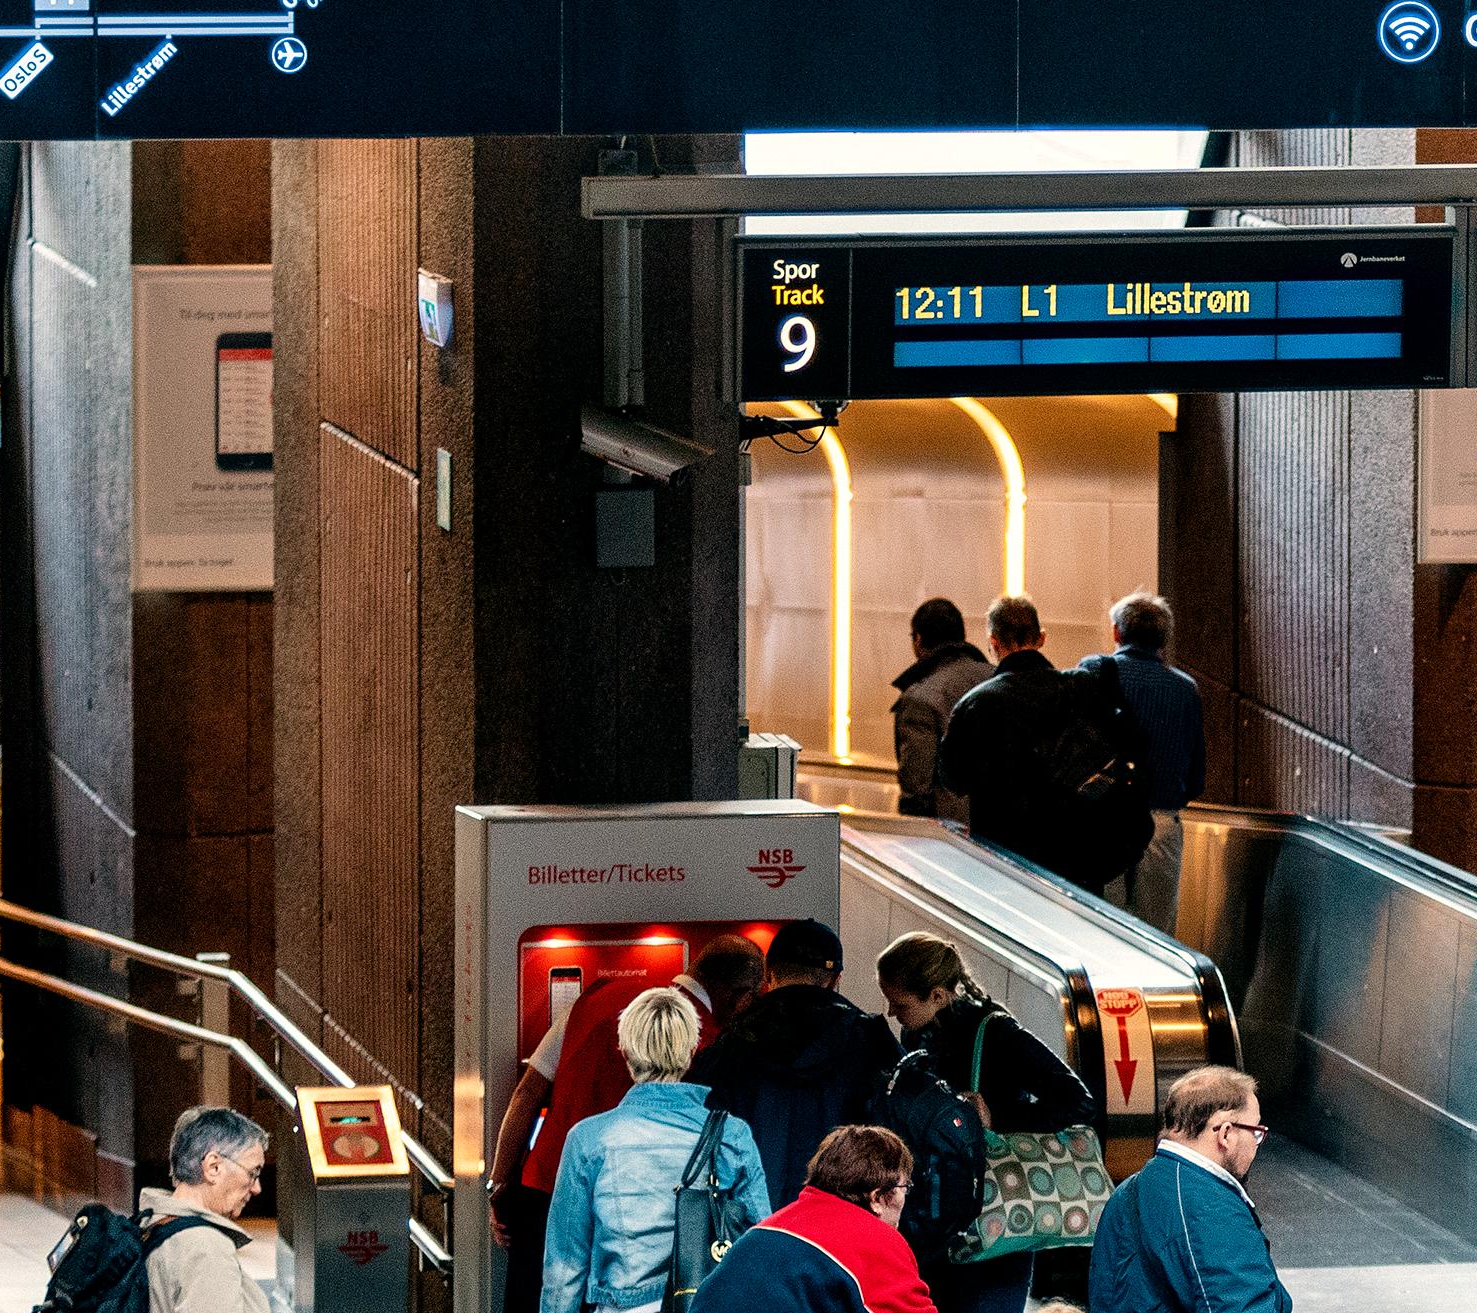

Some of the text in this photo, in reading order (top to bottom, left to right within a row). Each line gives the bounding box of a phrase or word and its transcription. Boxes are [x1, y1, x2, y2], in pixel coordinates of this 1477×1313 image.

[773, 260, 819, 283] Spor
[772, 284, 824, 305] Track
[896, 281, 1250, 321] 12:11 L1 Lillestrøm
[781, 316, 815, 372] 9
[758, 849, 793, 864] NSB
[527, 863, 686, 888] Billetter/Tickets
